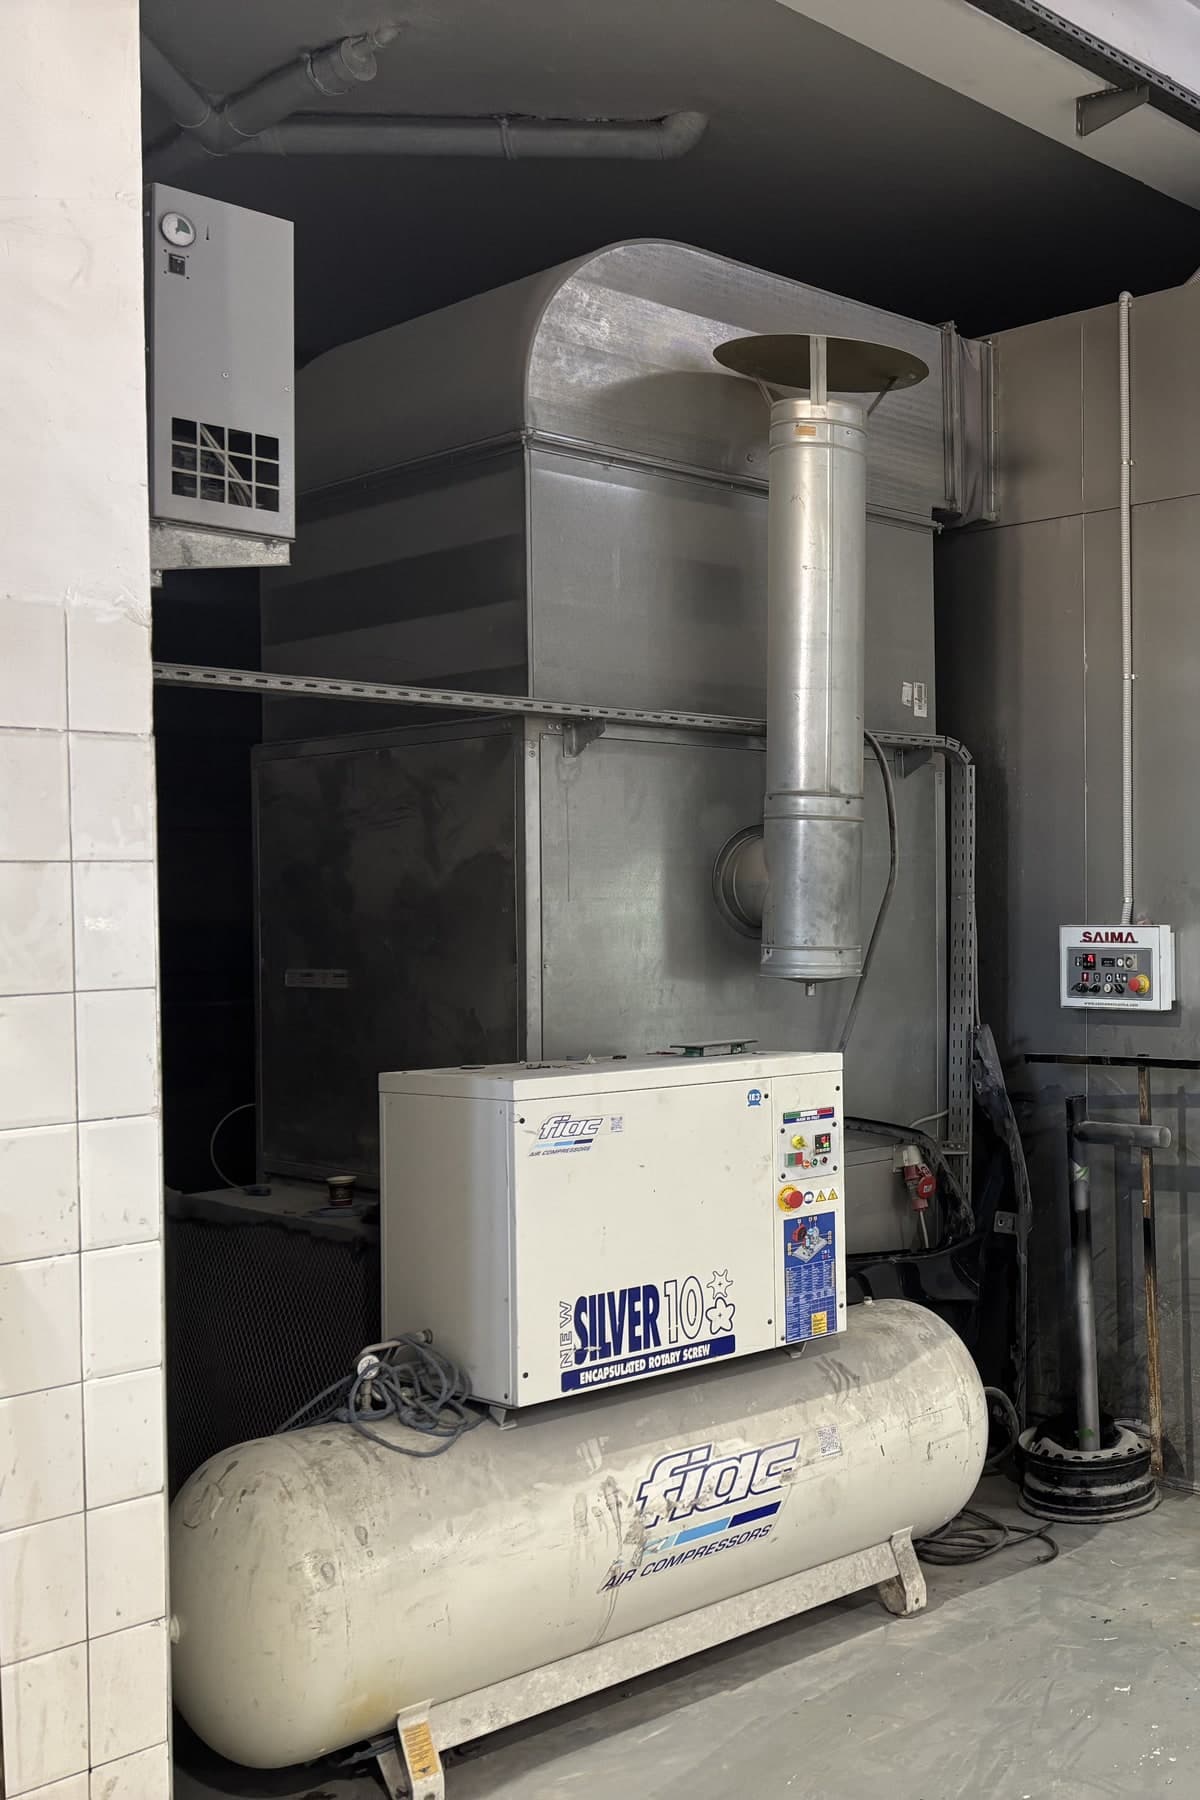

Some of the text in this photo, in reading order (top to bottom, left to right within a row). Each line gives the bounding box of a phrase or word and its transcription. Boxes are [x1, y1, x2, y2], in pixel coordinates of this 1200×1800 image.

[1081, 931, 1137, 943] SAIMA
[538, 1114, 603, 1140] fiac
[560, 1301, 573, 1369] NEW
[573, 1284, 662, 1366] SILVER
[663, 1275, 704, 1345] 10
[579, 1343, 711, 1385] ENCAPSULATED ROTARY SCREW
[635, 1438, 801, 1529] fiac
[599, 1523, 773, 1592] AIR COMPRESSORS
